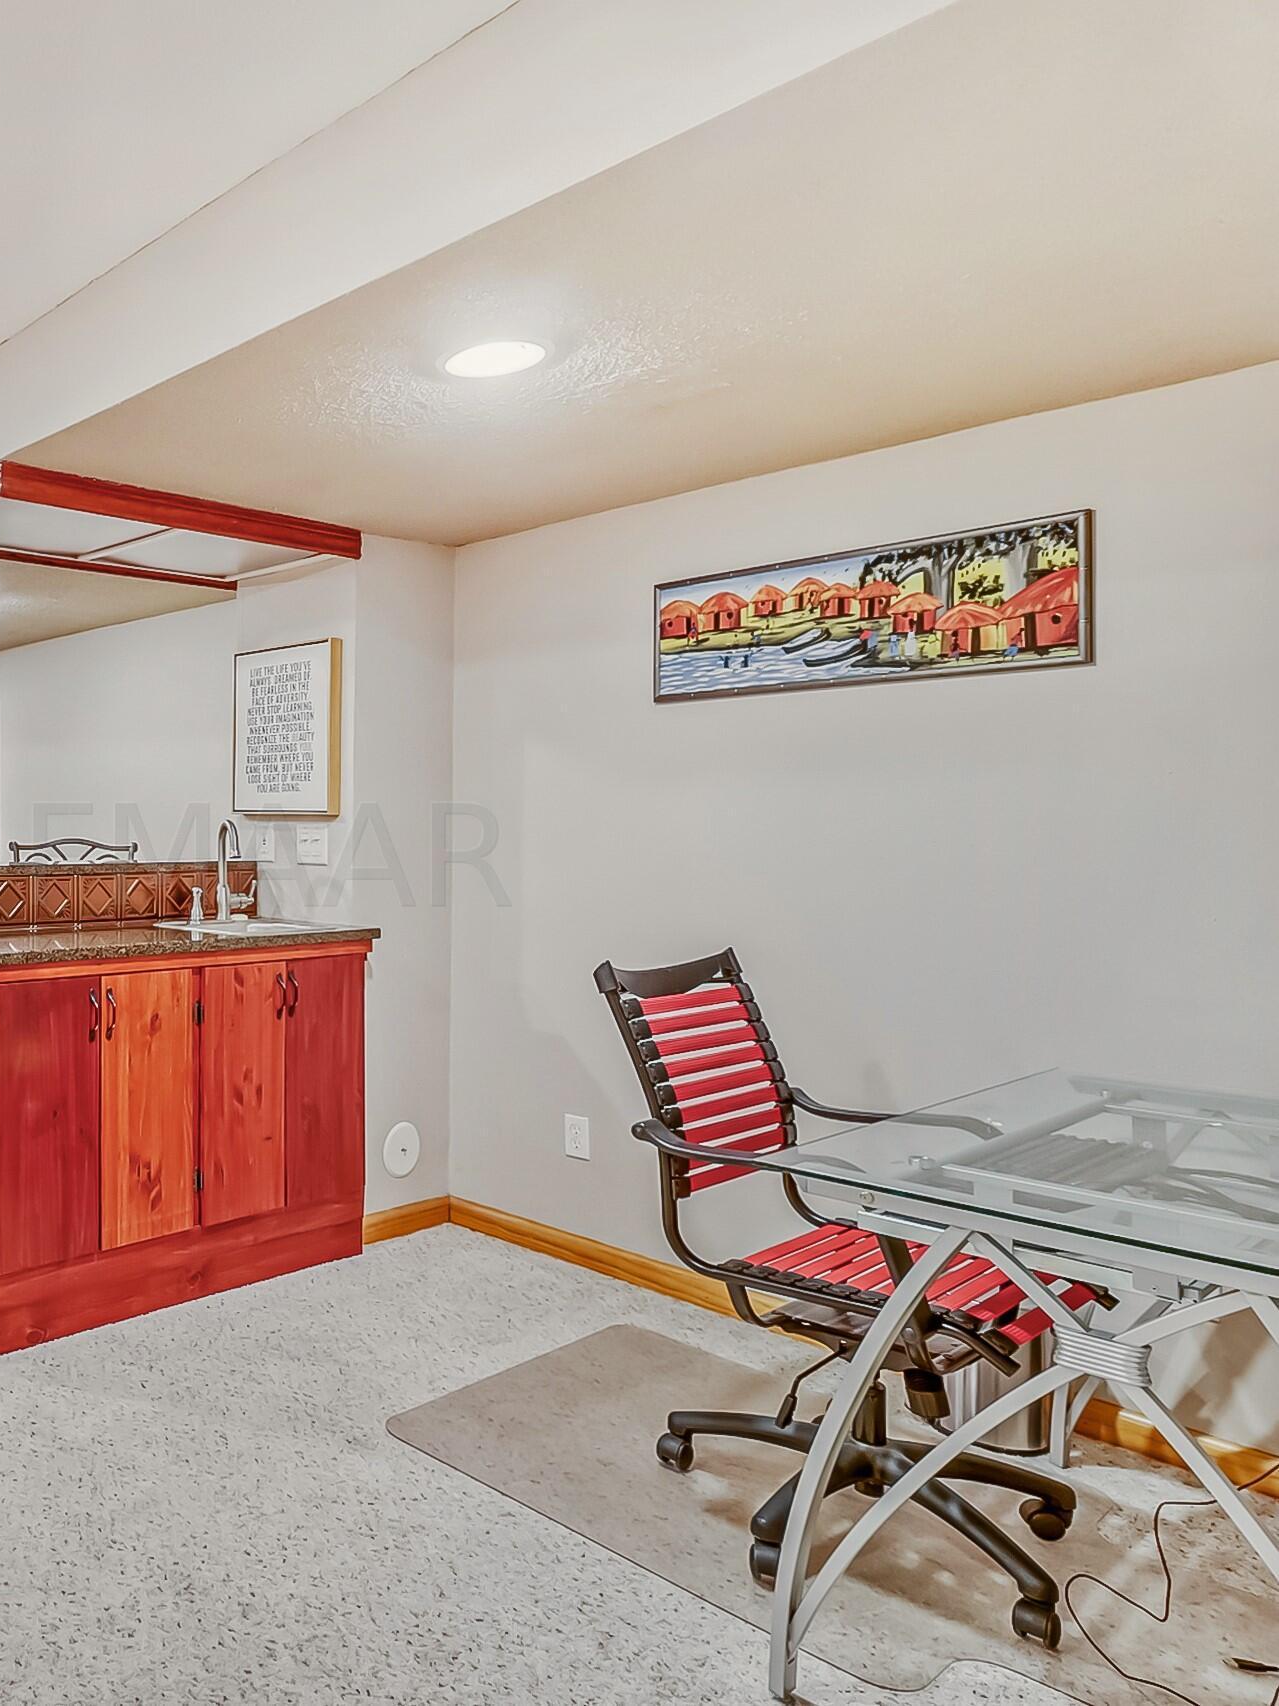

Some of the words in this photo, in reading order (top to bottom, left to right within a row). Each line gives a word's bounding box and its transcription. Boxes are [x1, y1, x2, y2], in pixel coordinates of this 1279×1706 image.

[276, 664, 289, 675] LIFE
[260, 684, 289, 696] FEARLESS
[248, 707, 265, 717] NEVER
[267, 706, 281, 715] STOP
[248, 746, 261, 755] THAT
[280, 752, 300, 762] WHERE
[295, 762, 314, 772] NEVER
